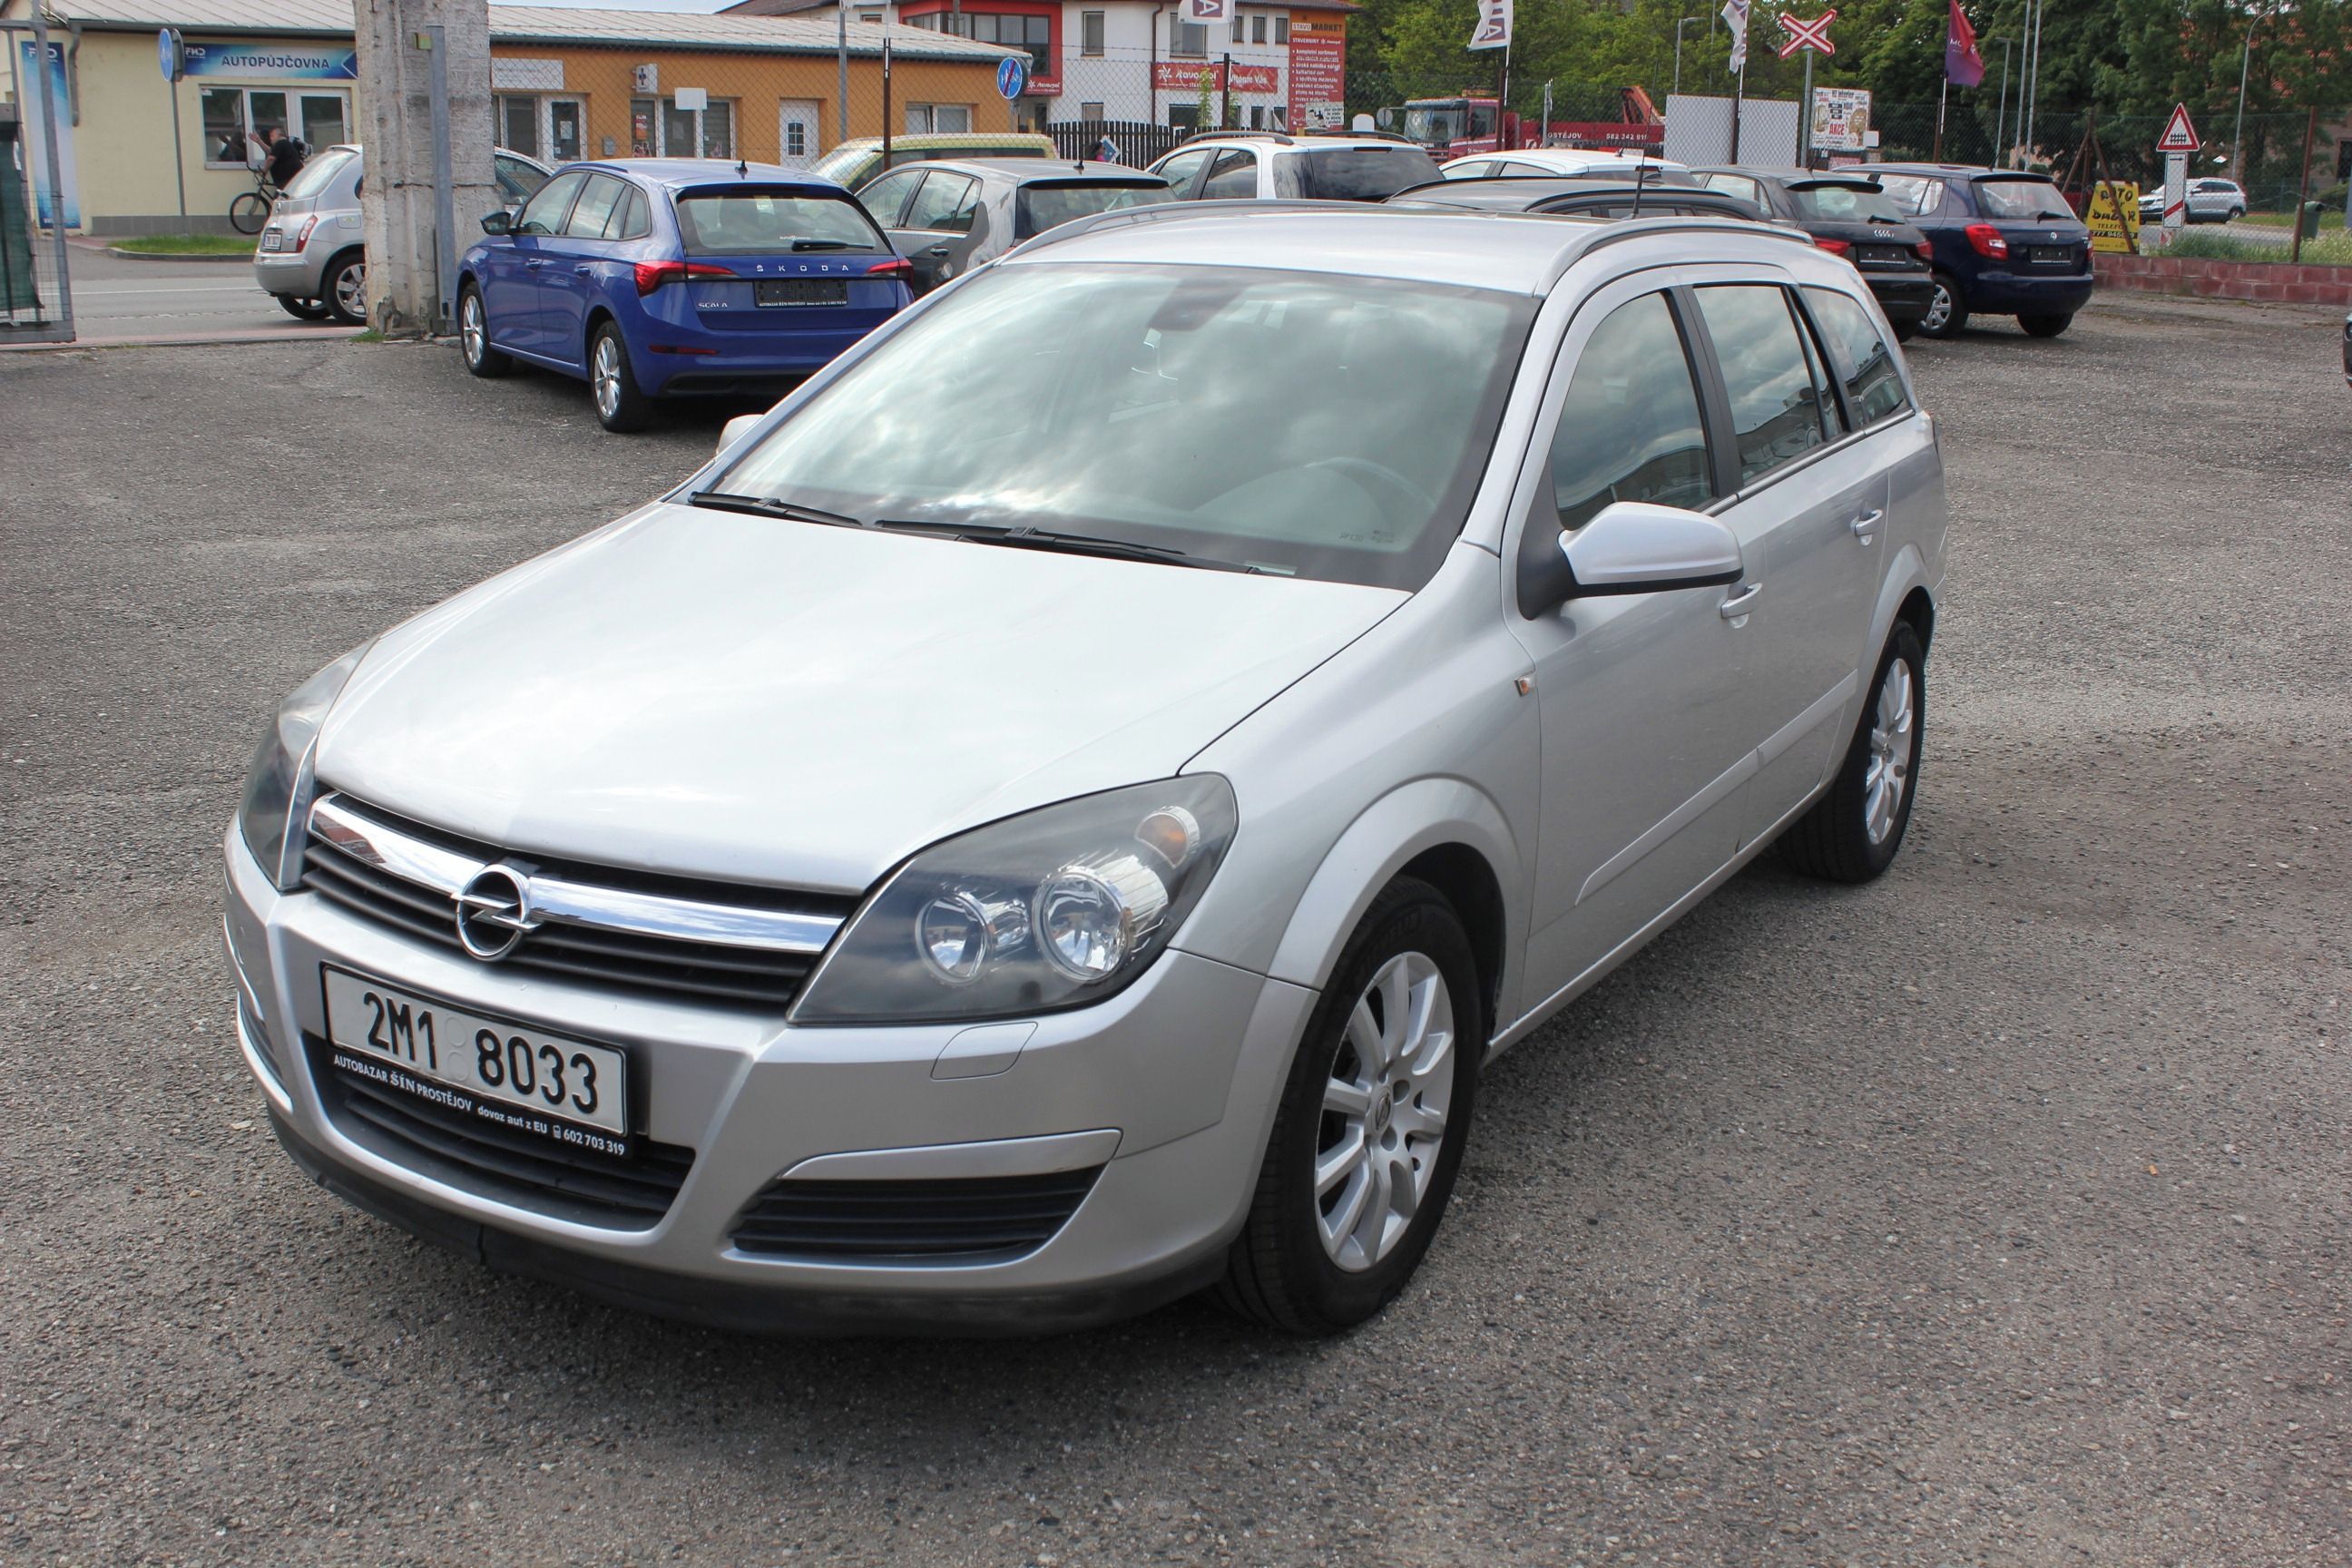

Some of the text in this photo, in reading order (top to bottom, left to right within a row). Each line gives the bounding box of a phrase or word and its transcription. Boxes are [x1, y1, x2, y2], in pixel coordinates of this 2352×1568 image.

[221, 54, 330, 69] AUTOPŮJČOVNA
[1829, 123, 1845, 135] AKCE
[364, 991, 599, 1115] 2M1 8033
[334, 1054, 625, 1157] AUTOBAZAR ŠÍN PROSTĚJOV dovoz aut z EU 602 703 319
